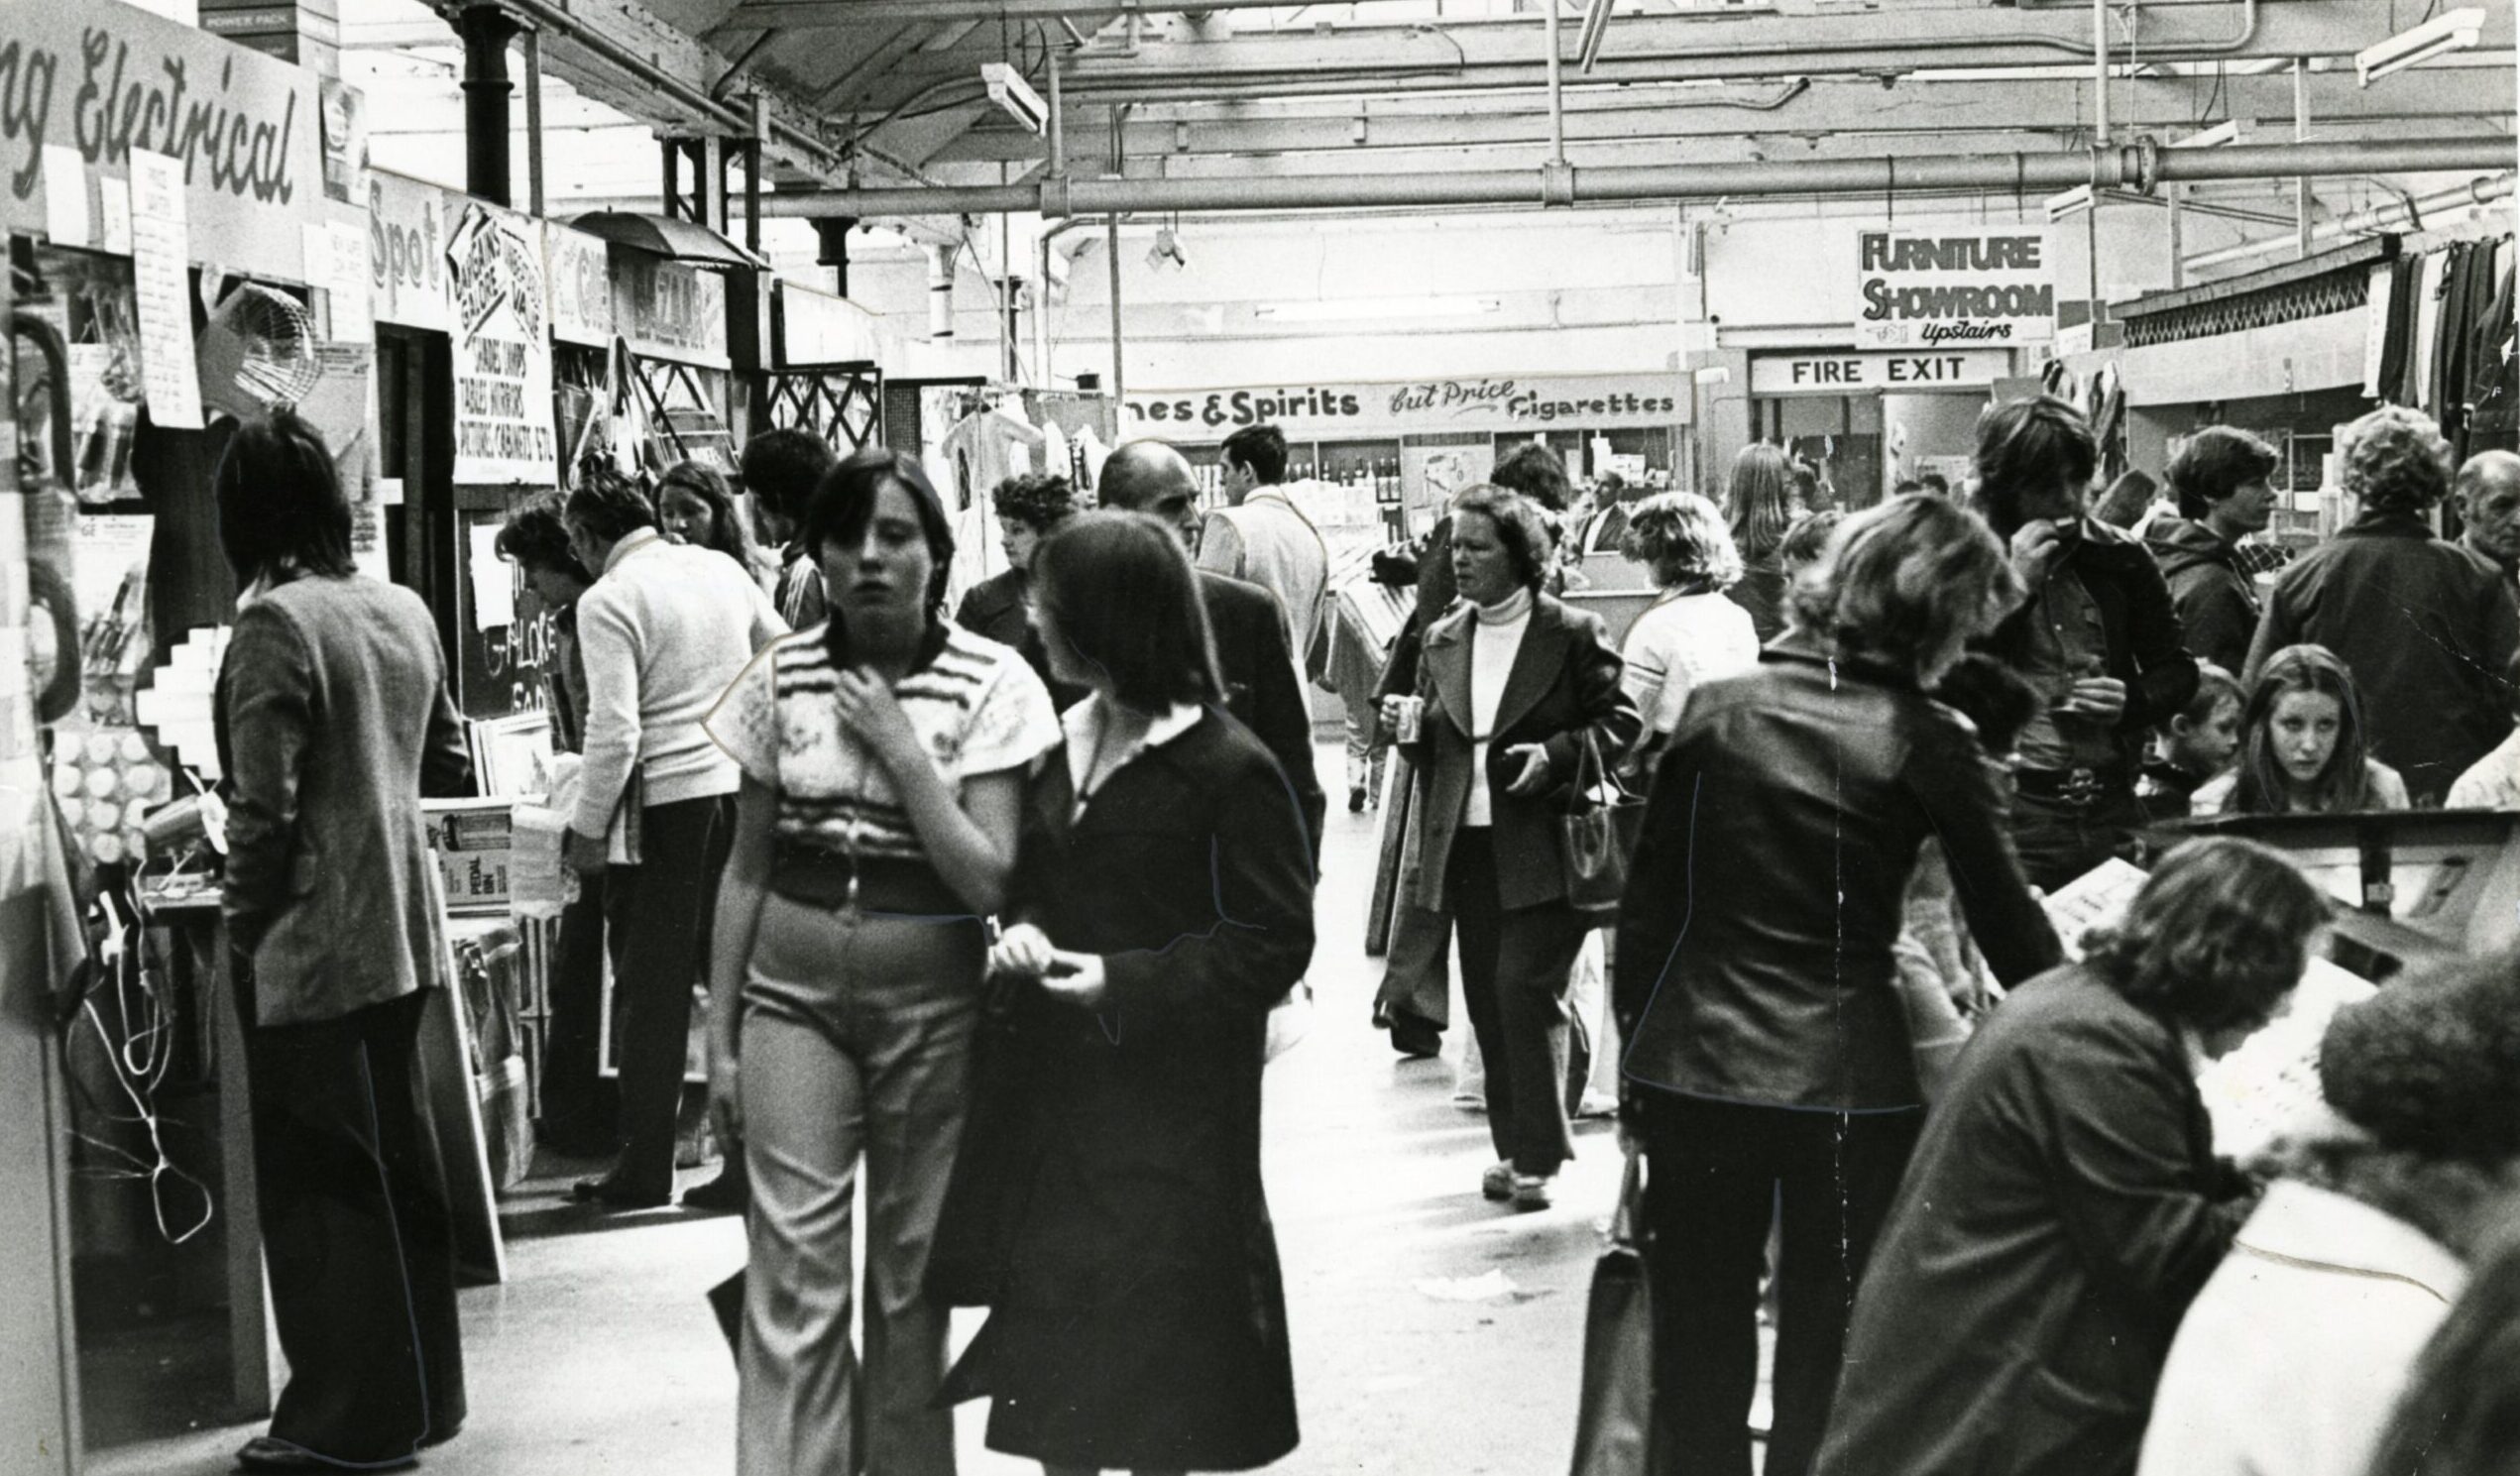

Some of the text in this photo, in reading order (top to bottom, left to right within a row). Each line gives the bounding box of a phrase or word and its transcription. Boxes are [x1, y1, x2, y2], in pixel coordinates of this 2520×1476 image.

[74, 26, 296, 205] Electrical
[370, 179, 439, 317] Spot
[1862, 233, 2042, 272] FURNITURE
[1862, 278, 2054, 321] SHOWROOM
[1921, 319, 2013, 347] Upstairs
[1792, 357, 1965, 384] FIRE EXIT
[1230, 387, 1360, 426] Spirits
[1443, 379, 1516, 406] Price
[1507, 390, 1674, 420] Cigarettes
[469, 855, 482, 895] PEDAL
[483, 873, 495, 894] BIN
